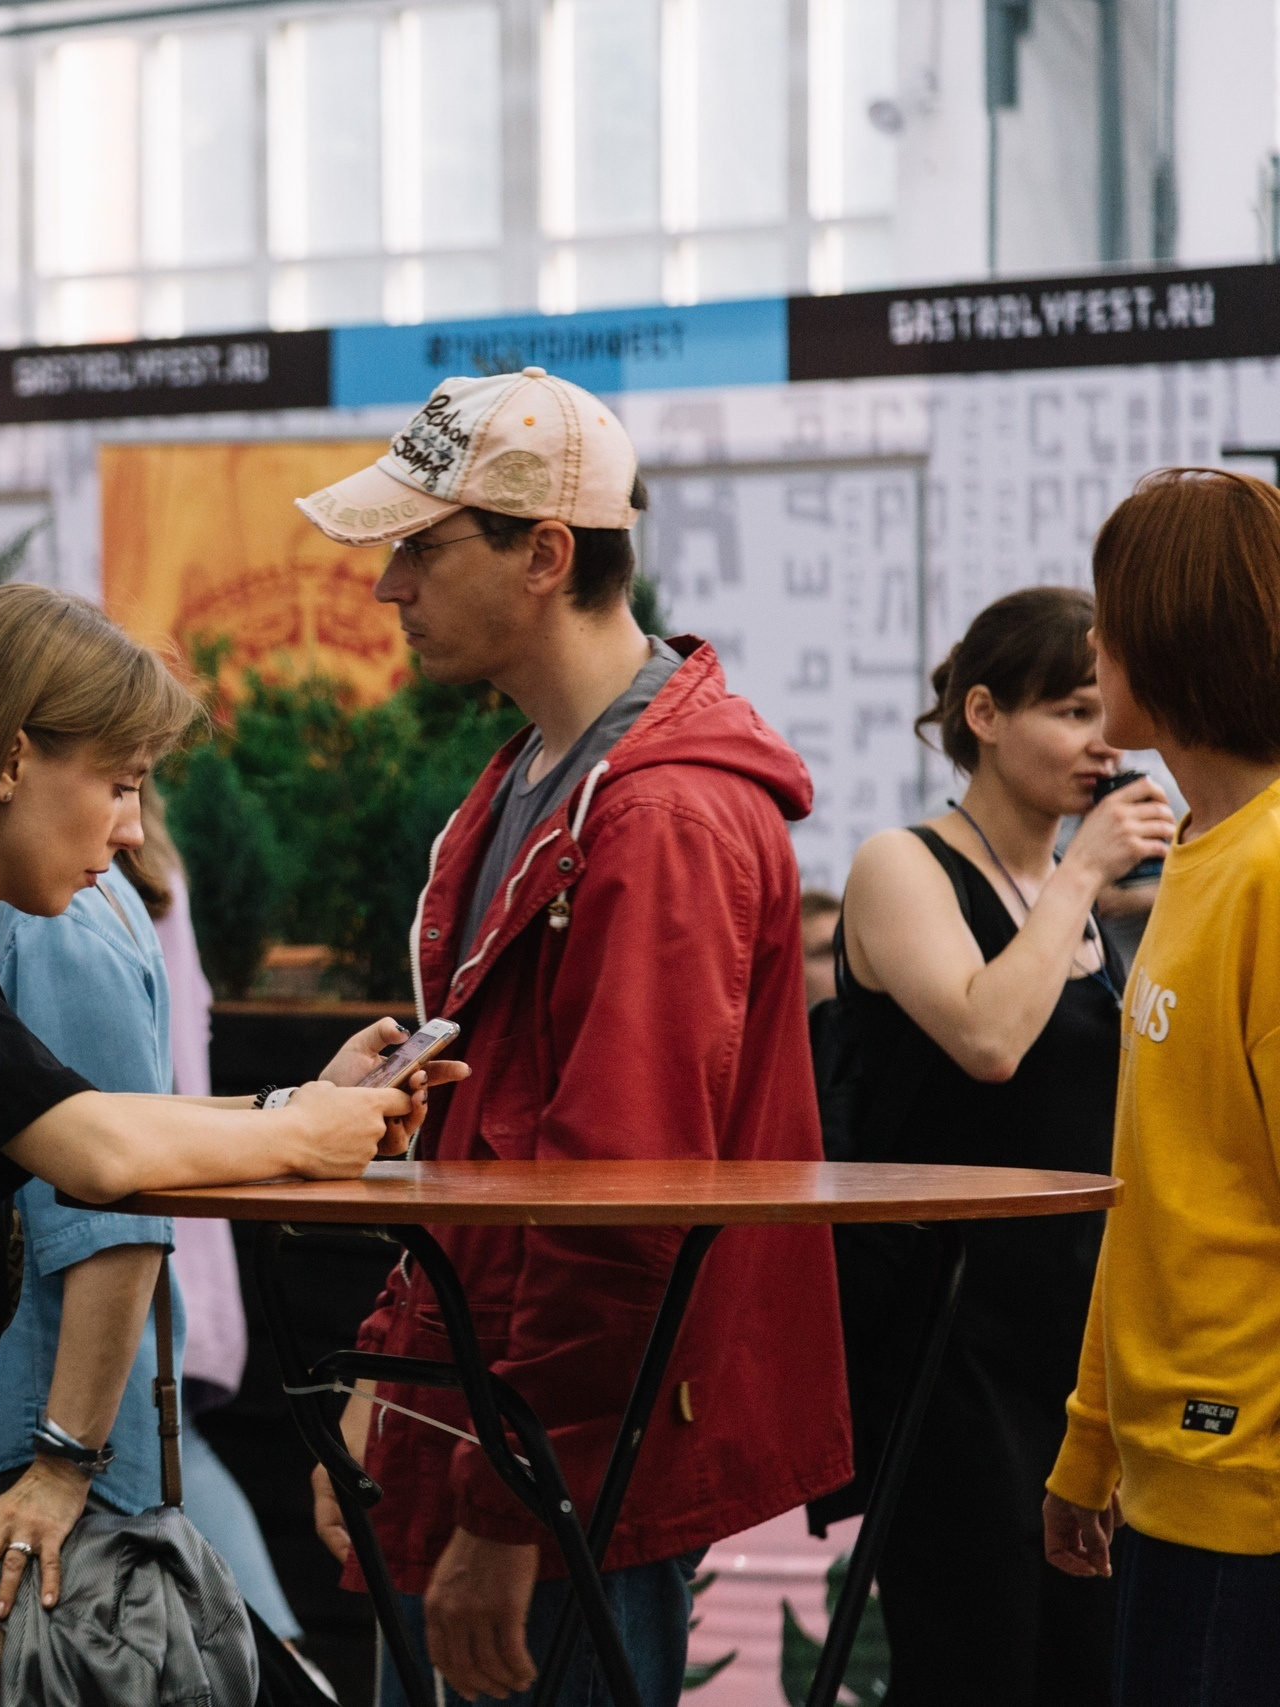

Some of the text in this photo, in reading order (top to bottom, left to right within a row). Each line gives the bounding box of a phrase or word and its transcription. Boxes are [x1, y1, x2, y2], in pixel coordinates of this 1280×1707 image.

[888, 283, 1214, 345] GASTROLYFEST.RU
[1196, 1403, 1236, 1419] SINCE DAY
[1204, 1418, 1221, 1432] ONE
